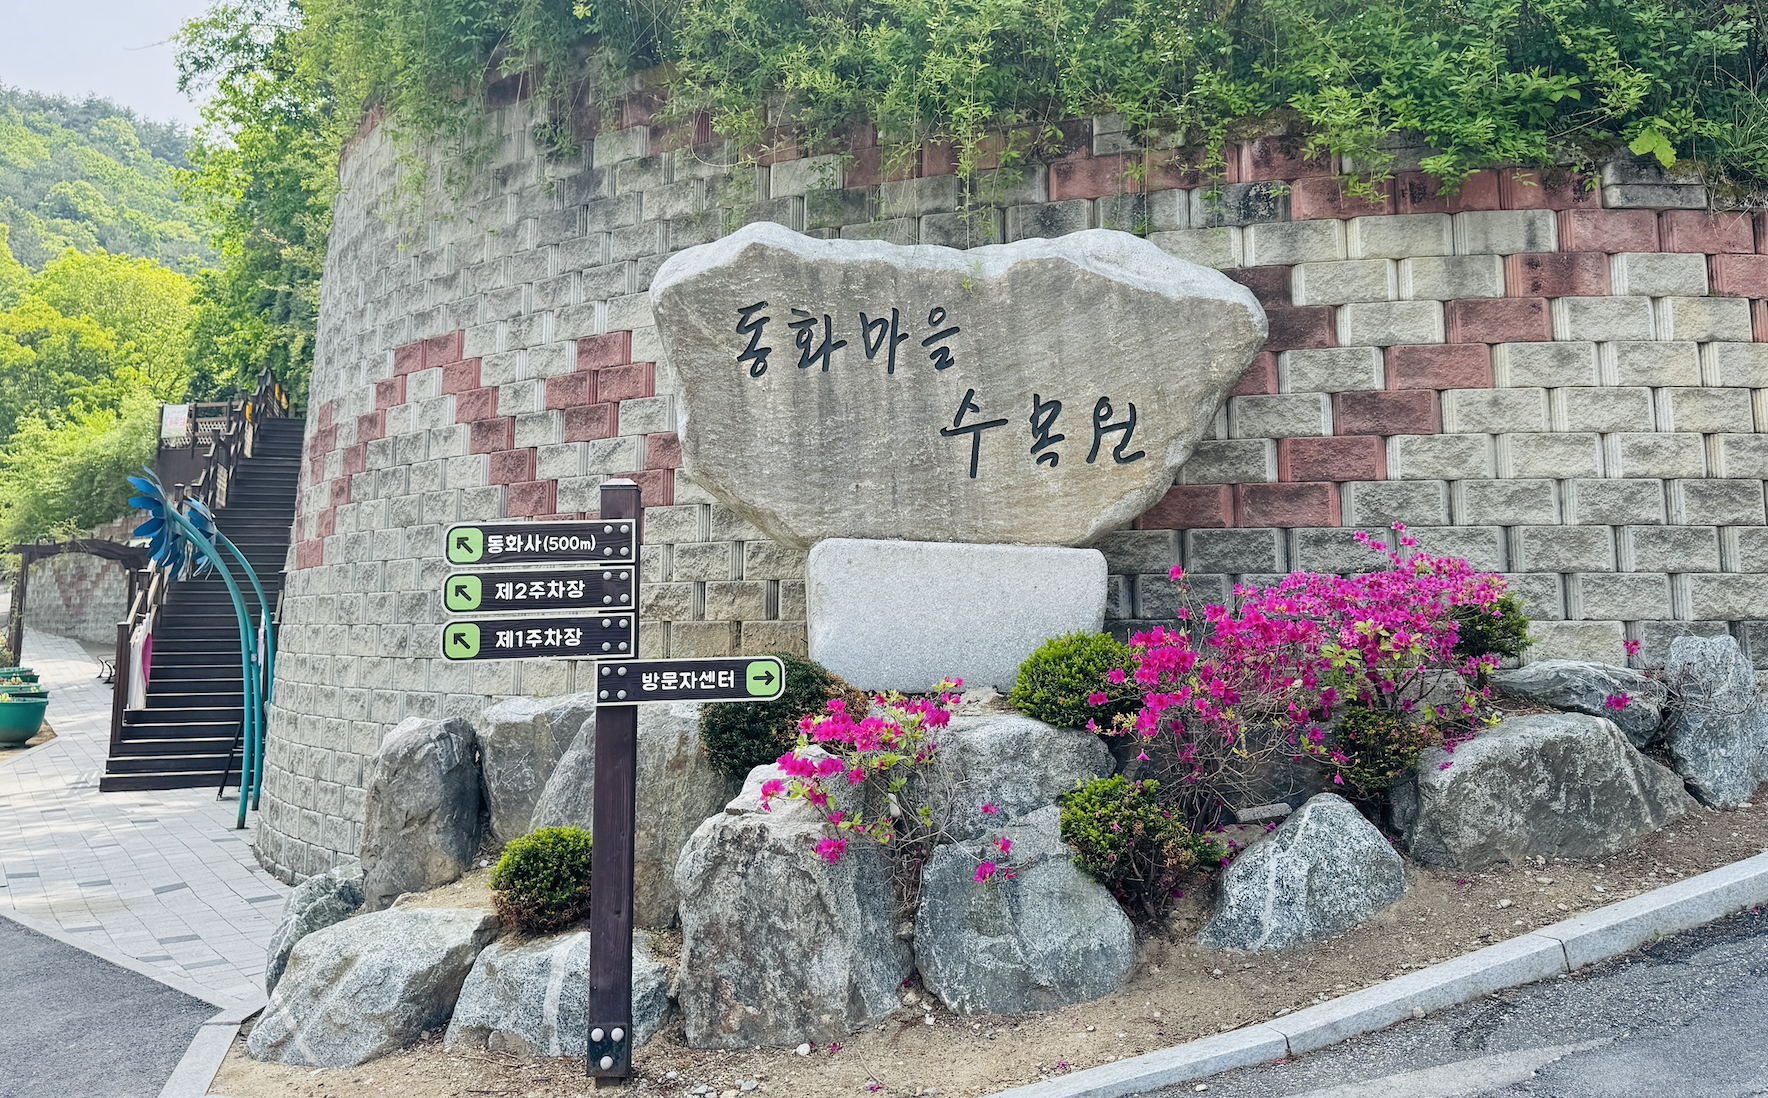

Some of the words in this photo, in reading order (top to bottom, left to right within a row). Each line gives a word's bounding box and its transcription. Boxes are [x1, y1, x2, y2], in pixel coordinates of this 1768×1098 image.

[735, 301, 960, 377] 동화마을
[940, 388, 1146, 479] 수목원
[487, 534, 597, 552] 동화사(500m)
[494, 580, 586, 600] 제2주차장
[495, 628, 583, 648] 제1주차장
[641, 670, 735, 691] 방문자센터
